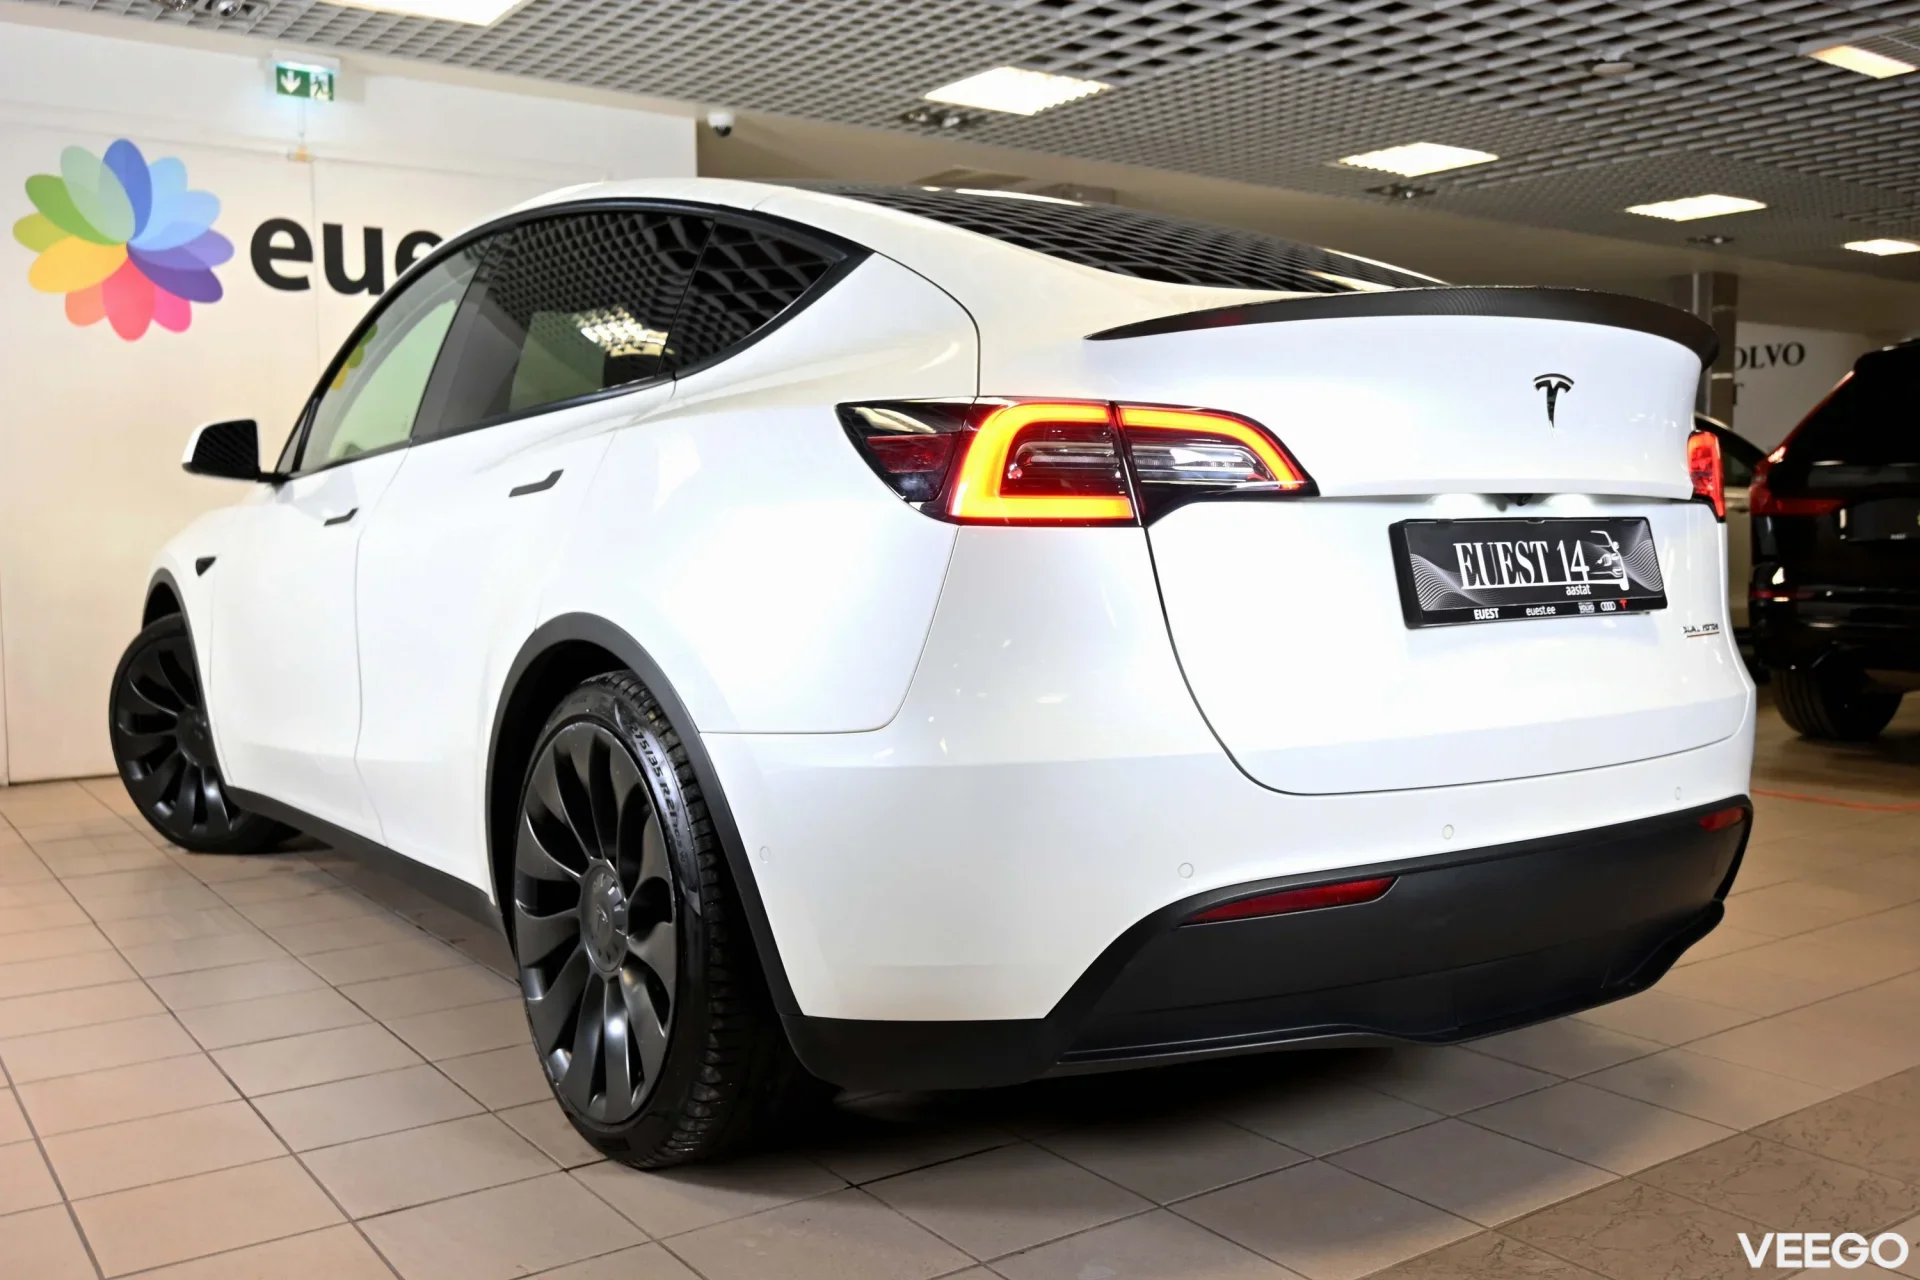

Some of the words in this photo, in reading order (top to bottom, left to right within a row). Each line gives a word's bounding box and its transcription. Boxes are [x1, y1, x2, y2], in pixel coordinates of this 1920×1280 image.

[1735, 341, 1805, 371] OLVO
[1453, 541, 1549, 589] EUEST
[1556, 539, 1590, 583] 14
[1565, 584, 1592, 596] aastat
[1473, 608, 1500, 620] EUEST
[1525, 606, 1557, 617] euest.ee
